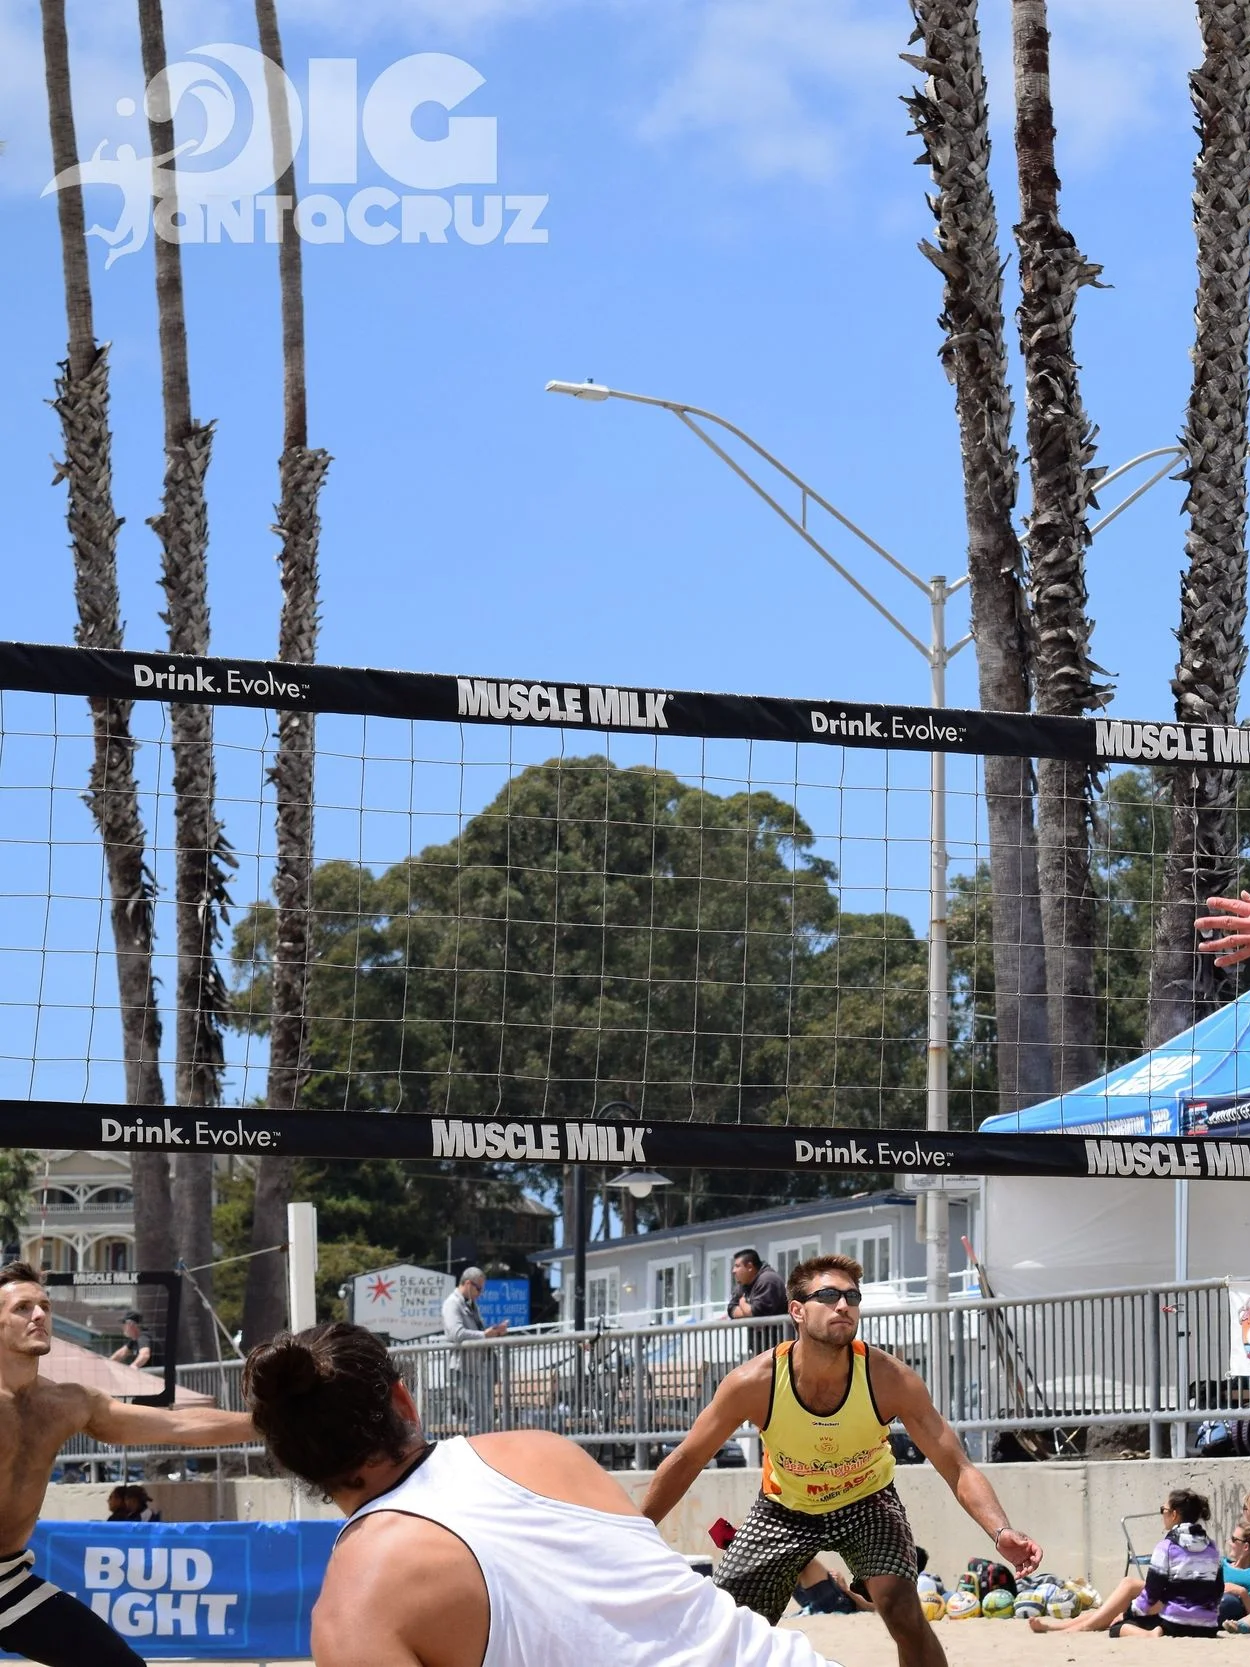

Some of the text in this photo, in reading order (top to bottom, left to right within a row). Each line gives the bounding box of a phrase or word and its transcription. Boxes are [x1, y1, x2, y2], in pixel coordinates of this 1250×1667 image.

[134, 663, 221, 694] Drink.
[456, 677, 670, 729] MUSCLE MILK
[811, 711, 888, 739] Drink.
[1095, 720, 1208, 762] MUSCLE
[101, 1118, 191, 1146] Drink.
[431, 1118, 647, 1163] MUSCLE MILK
[795, 1139, 874, 1165] Drink.
[1085, 1139, 1201, 1176] MUSCLE
[73, 1272, 138, 1285] MUSCLE MILK
[400, 1276, 445, 1286] BEACH
[400, 1286, 445, 1297] STREET
[401, 1298, 425, 1306] INN
[84, 1546, 213, 1591] BUD
[67, 1592, 238, 1638] IGHT
